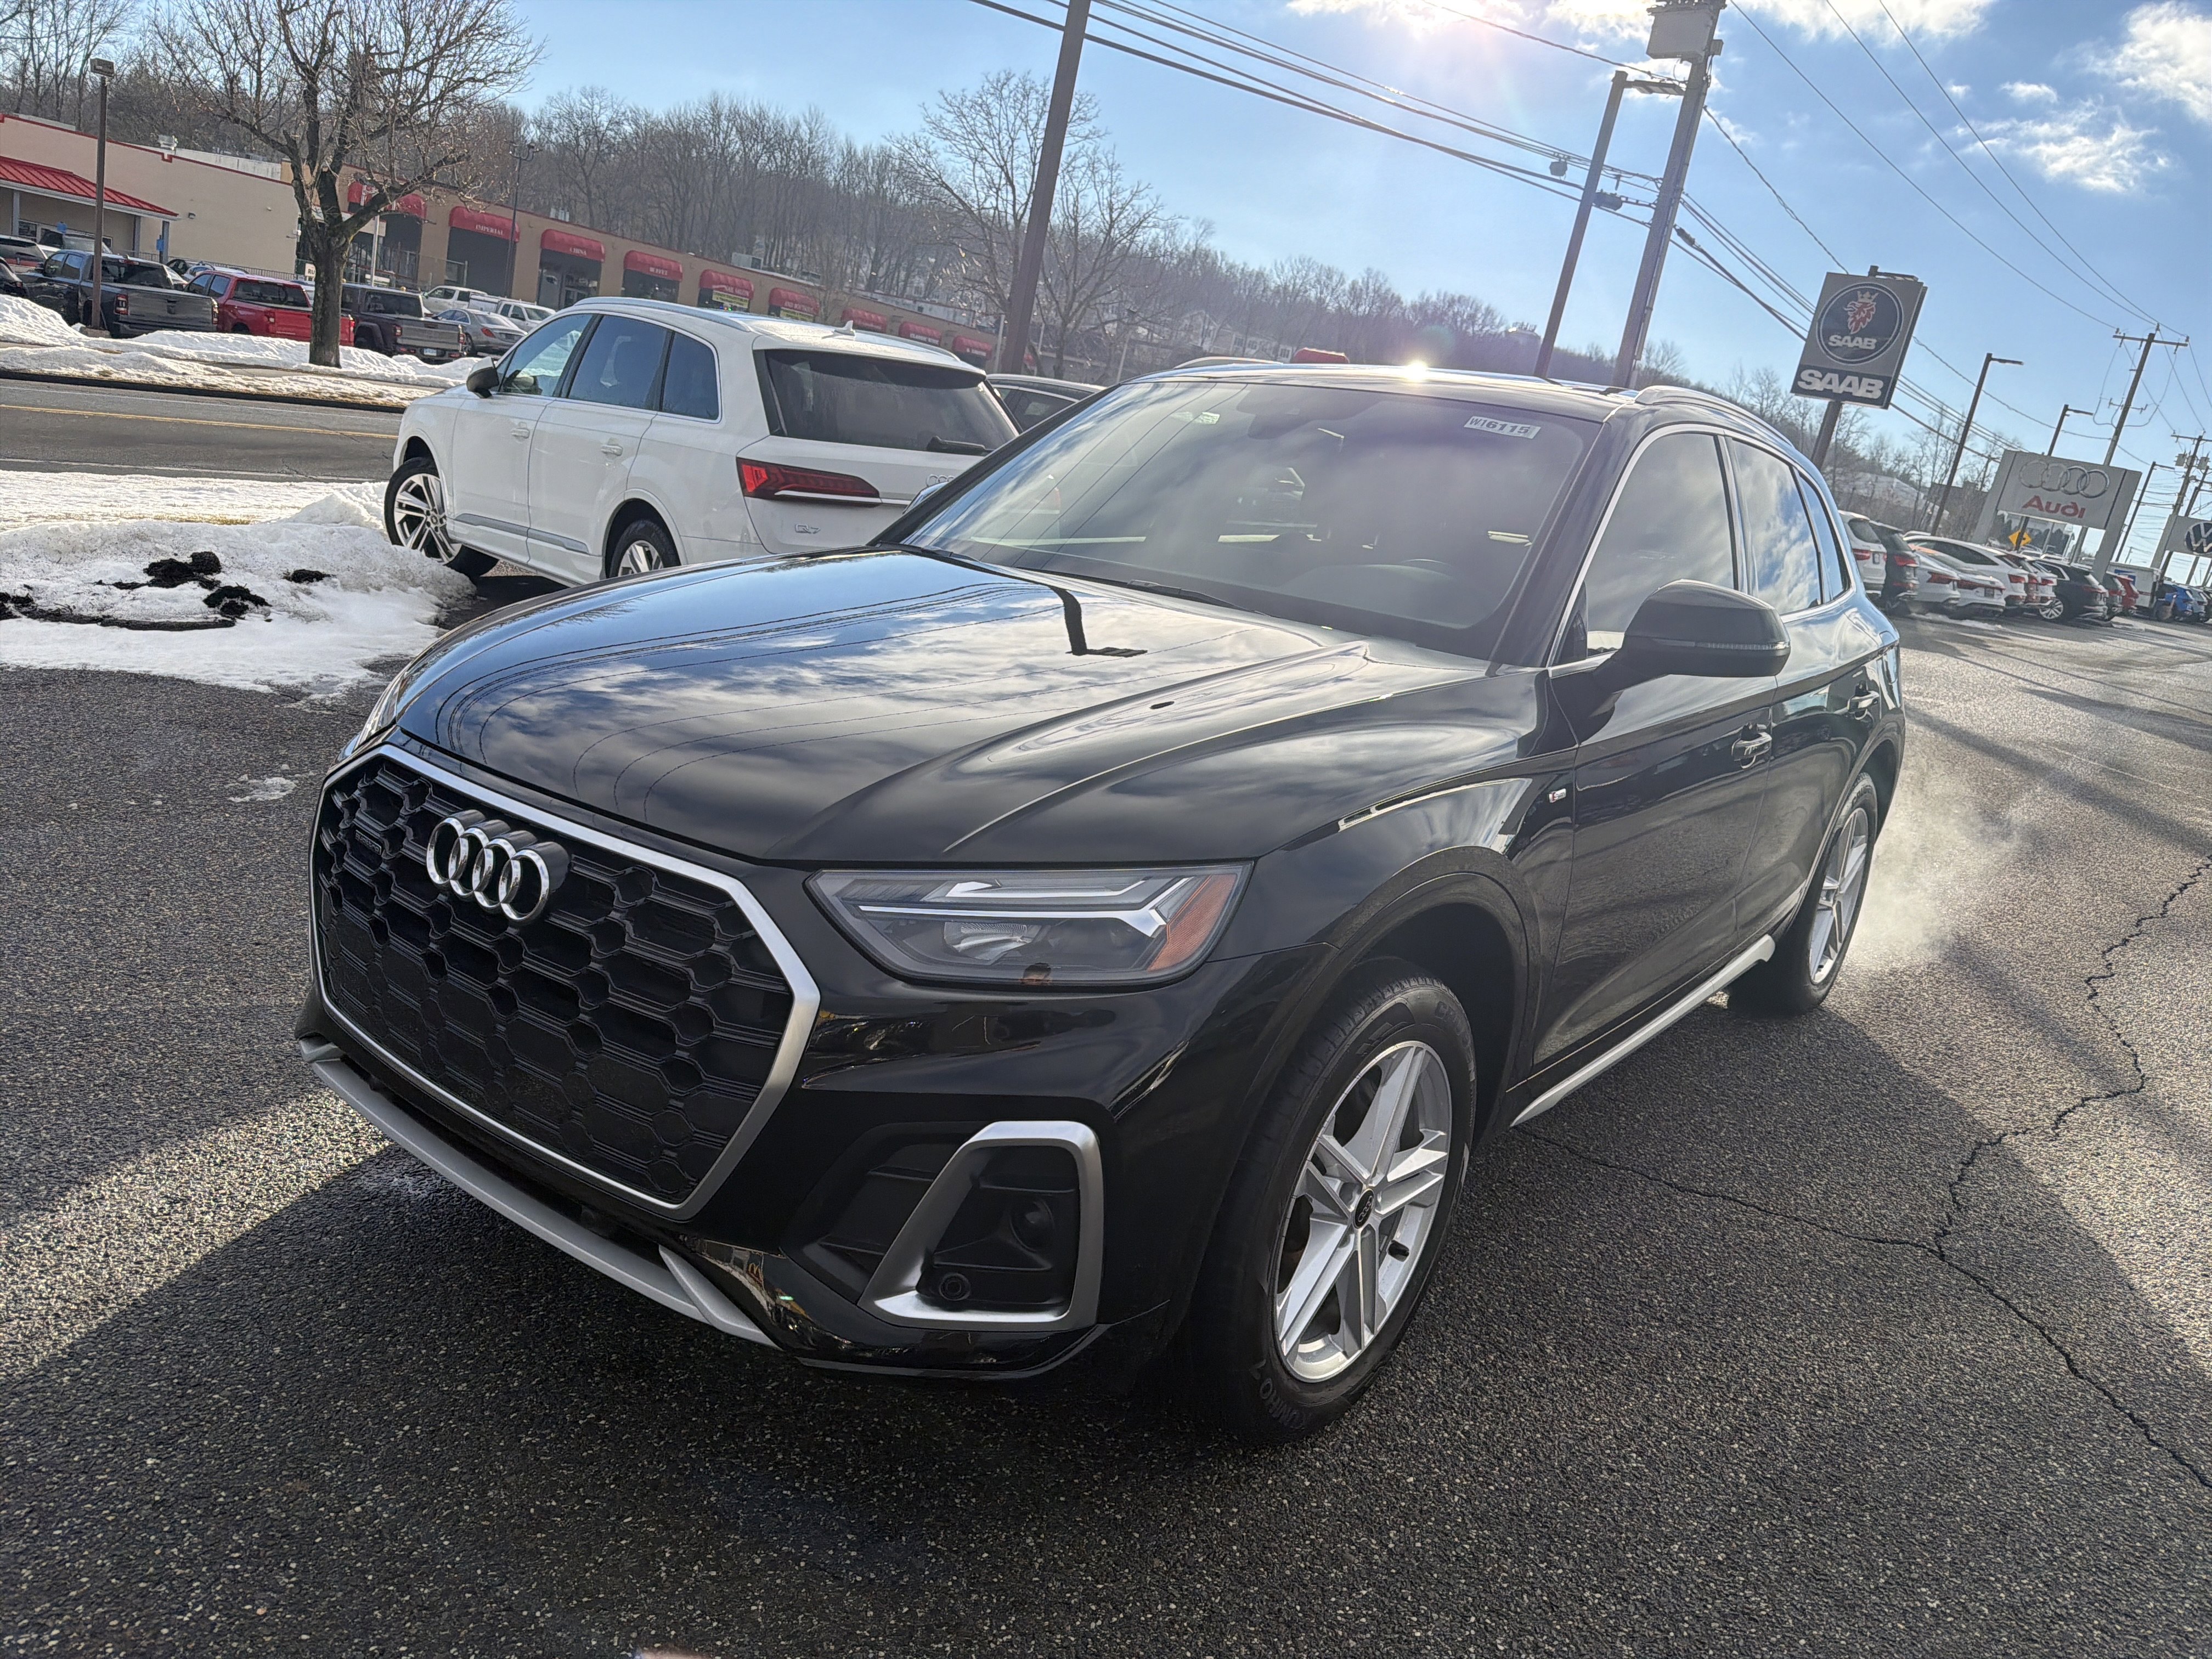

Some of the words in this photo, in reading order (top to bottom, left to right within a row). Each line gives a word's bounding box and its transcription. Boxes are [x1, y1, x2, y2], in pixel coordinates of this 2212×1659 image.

[475, 224, 504, 236] IMPERIAL
[569, 247, 587, 256] CHINA
[649, 267, 668, 276] BUFFET
[1828, 335, 1877, 349] SAAB
[1797, 369, 1883, 399] SAAB
[1469, 417, 1530, 434] W16115
[2022, 495, 2087, 519] Audi
[795, 523, 821, 534] Q7
[355, 832, 379, 853] quattro
